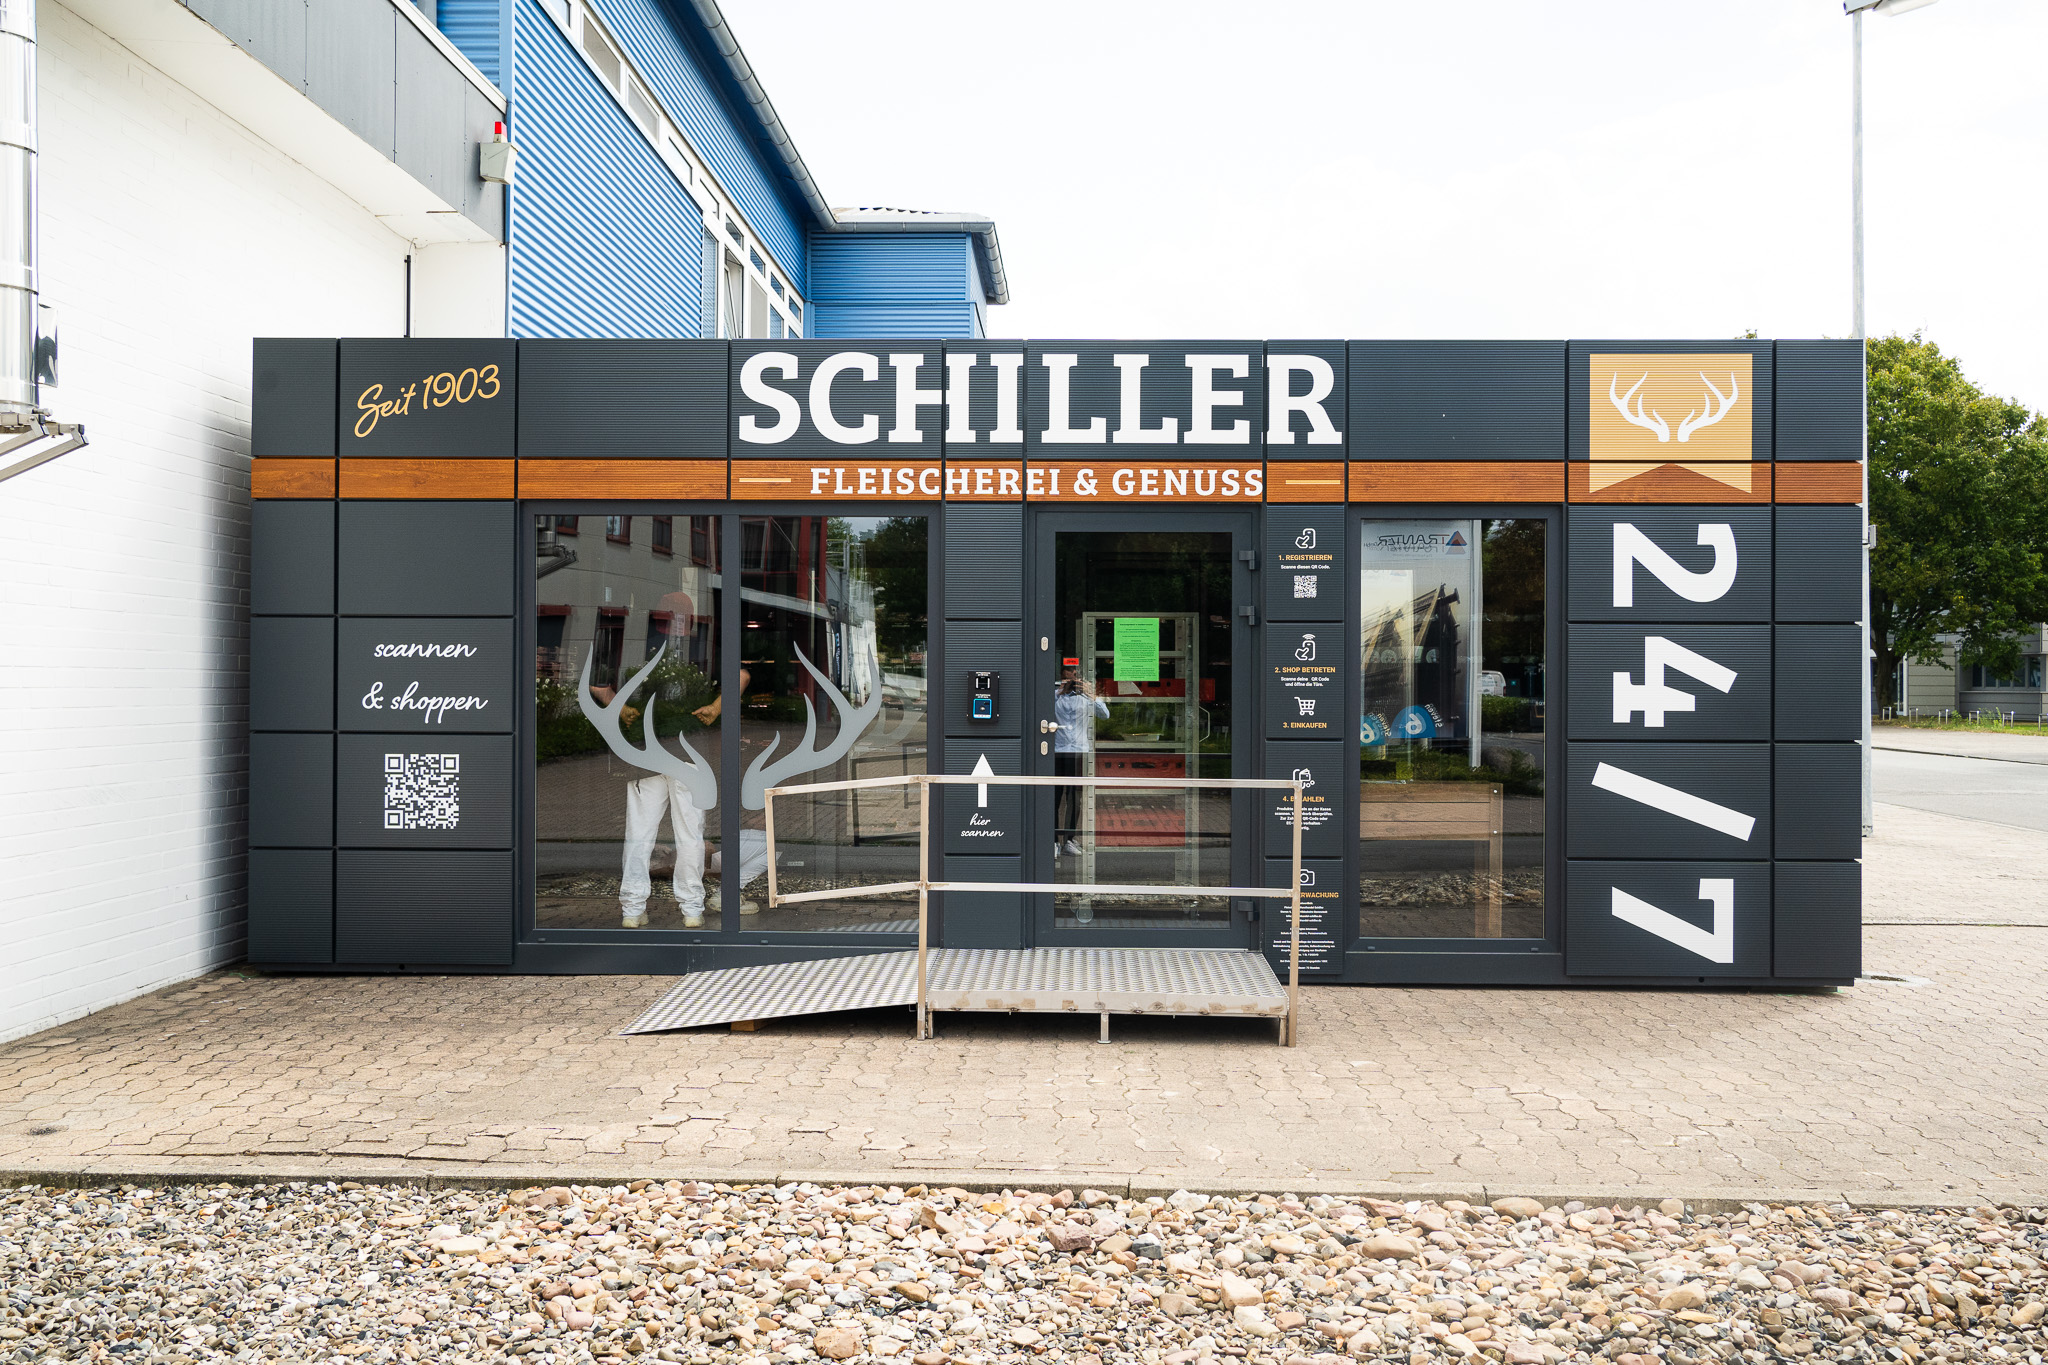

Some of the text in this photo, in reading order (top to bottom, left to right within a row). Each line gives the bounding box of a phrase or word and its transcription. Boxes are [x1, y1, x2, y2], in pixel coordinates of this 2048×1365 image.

[354, 363, 501, 438] Seit 1903
[738, 351, 1343, 445] SCHILLER
[810, 467, 1264, 497] FLEISCHEREI & GENUSS
[373, 643, 478, 658] scannen
[361, 681, 489, 724] & shoppen
[1591, 522, 1757, 964] 24/7
[960, 829, 1005, 837] scannen
[969, 812, 991, 826] hier
